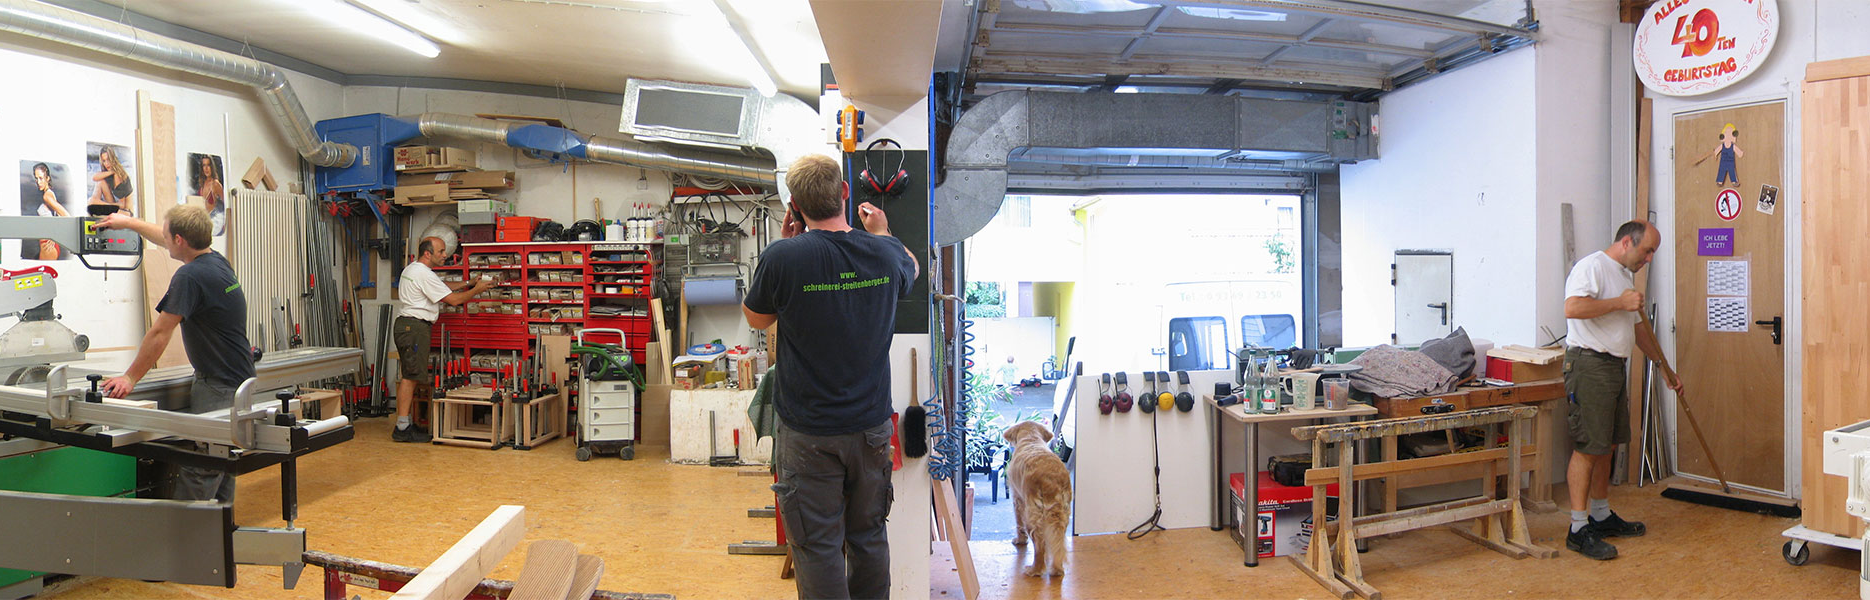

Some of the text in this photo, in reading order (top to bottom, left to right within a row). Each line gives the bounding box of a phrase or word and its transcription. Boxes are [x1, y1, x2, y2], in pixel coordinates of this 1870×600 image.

[1671, 8, 1720, 58] 40
[1717, 36, 1737, 50] TEN
[1664, 57, 1737, 82] GEBURTSTAG
